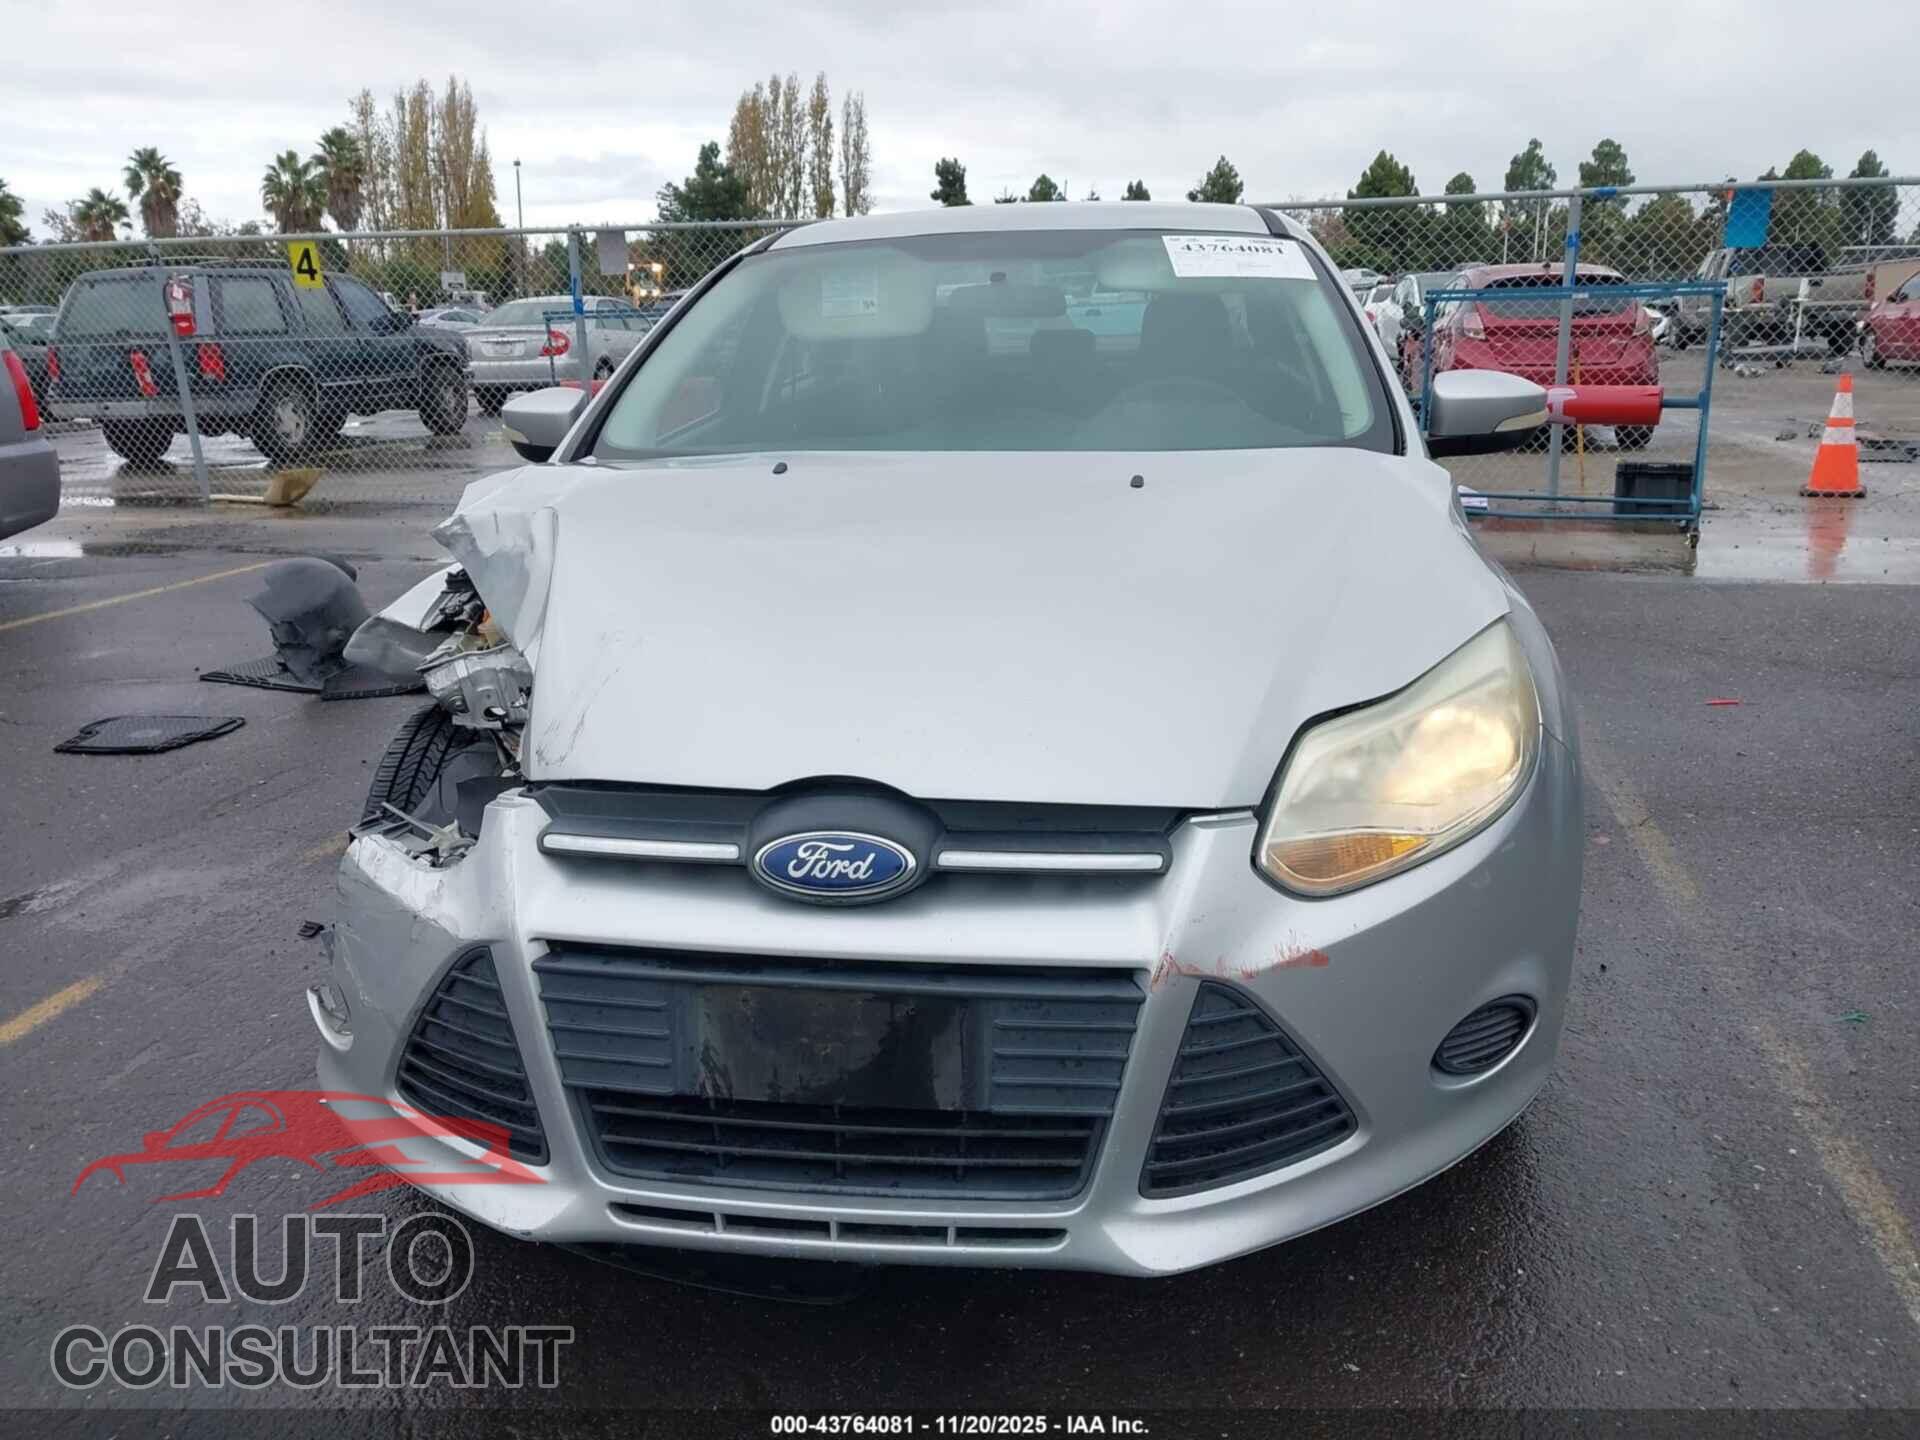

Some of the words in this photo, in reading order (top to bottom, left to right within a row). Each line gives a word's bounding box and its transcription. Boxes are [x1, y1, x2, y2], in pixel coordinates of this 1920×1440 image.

[297, 248, 318, 281] 4
[1181, 243, 1285, 255] 43764081
[787, 841, 876, 880] Ford
